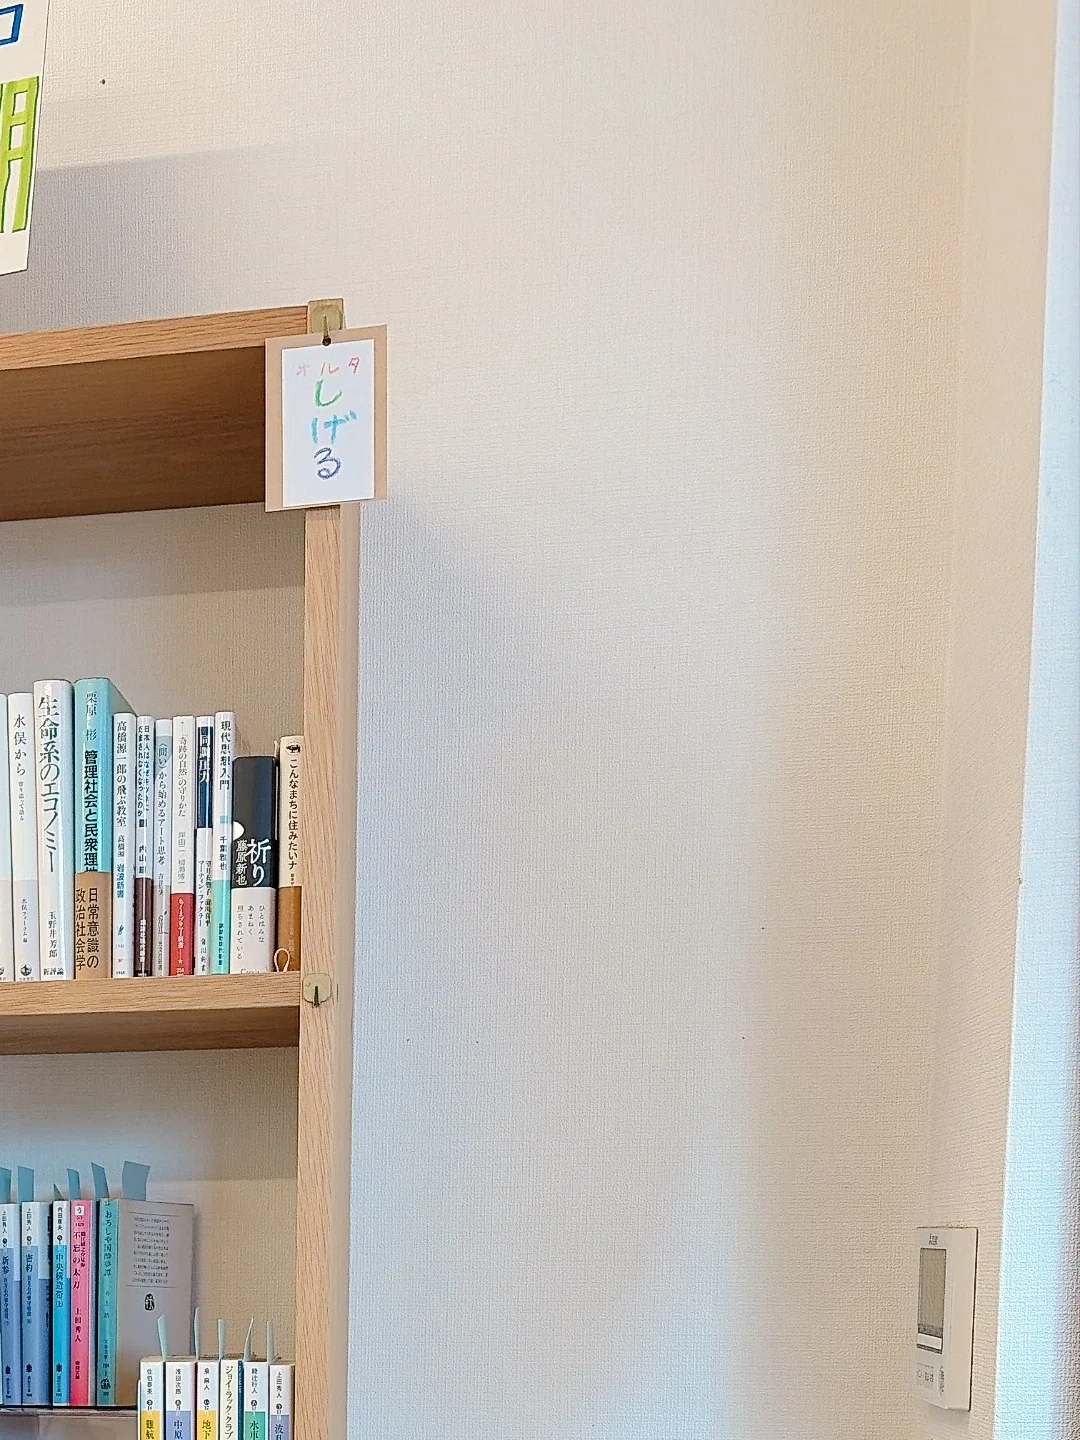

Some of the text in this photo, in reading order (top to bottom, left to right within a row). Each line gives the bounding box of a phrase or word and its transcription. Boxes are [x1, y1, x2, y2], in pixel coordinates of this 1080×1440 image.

[310, 379, 357, 480] しげる
[13, 714, 28, 777] 水俣から
[117, 721, 127, 827] 高橋源一郎の飛ぶ教室
[178, 735, 188, 817] 「奇跡の自然」の守りかた
[220, 720, 231, 791] 現代思想入門
[38, 695, 60, 873] 生命系のエコノミー
[157, 742, 168, 866] 〈問い〉から始めるアート思考
[287, 759, 299, 870] こんなまちに住みたいナ
[117, 864, 125, 898] 岩波新書
[219, 836, 228, 871] 千葉雅也
[236, 840, 248, 886] 藤原新也
[246, 838, 271, 887] 祈り
[48, 911, 58, 958] 玉野井芳郎
[75, 888, 87, 970] 政治社会学
[87, 888, 99, 968] 日常意識の
[43, 967, 64, 976] 新評論
[72, 1231, 81, 1290] 不忘の太刀
[104, 1210, 113, 1277] おろしや国酔夢譚
[145, 1419, 154, 1440] 難航
[225, 1365, 234, 1440] ジョイ・ラック・クラブ
